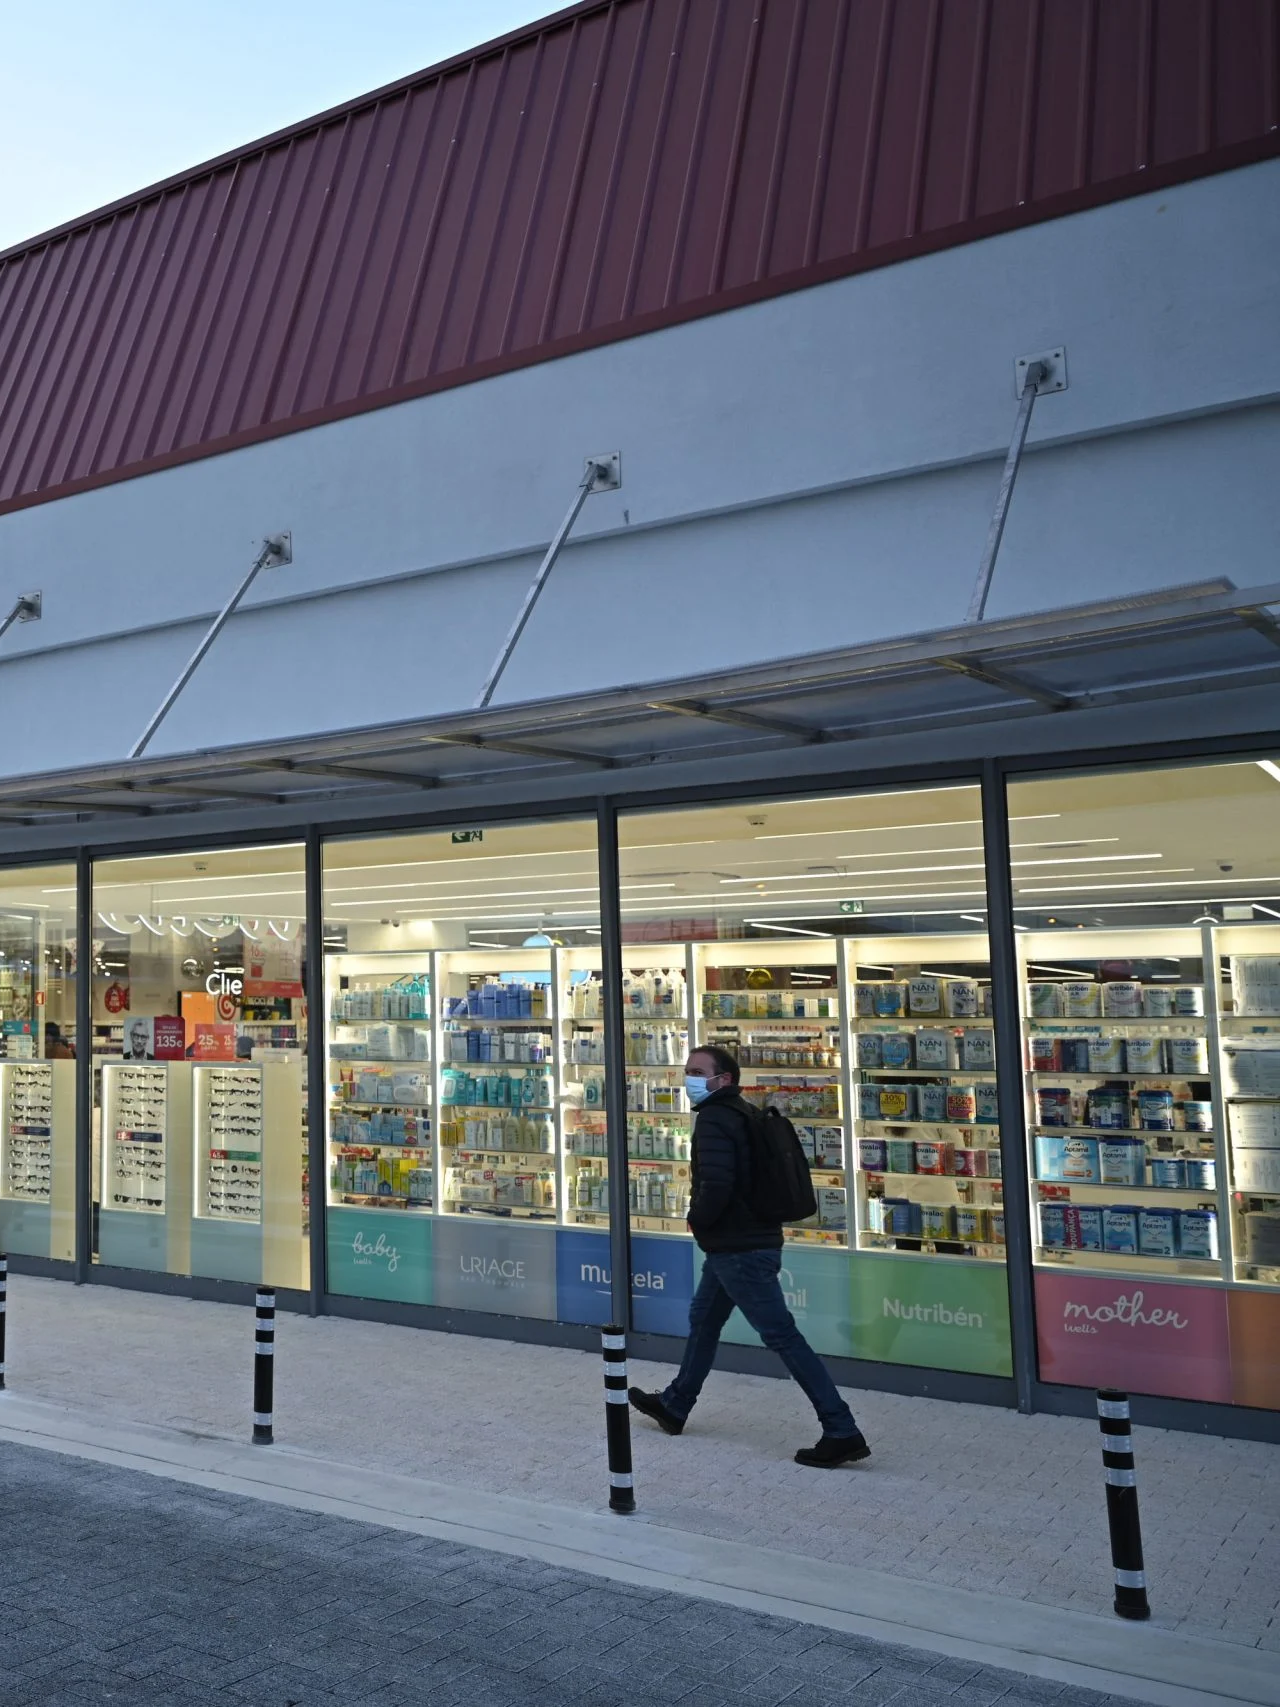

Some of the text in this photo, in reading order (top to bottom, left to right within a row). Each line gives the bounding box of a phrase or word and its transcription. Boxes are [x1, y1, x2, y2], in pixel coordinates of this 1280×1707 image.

[912, 983, 936, 992] NAN
[952, 987, 974, 996] NAN
[352, 1231, 400, 1272] baby
[460, 1255, 526, 1280] URIAGE
[580, 1263, 664, 1290] muela
[883, 1298, 983, 1328] Nutribén
[1063, 1290, 1189, 1329] mother
